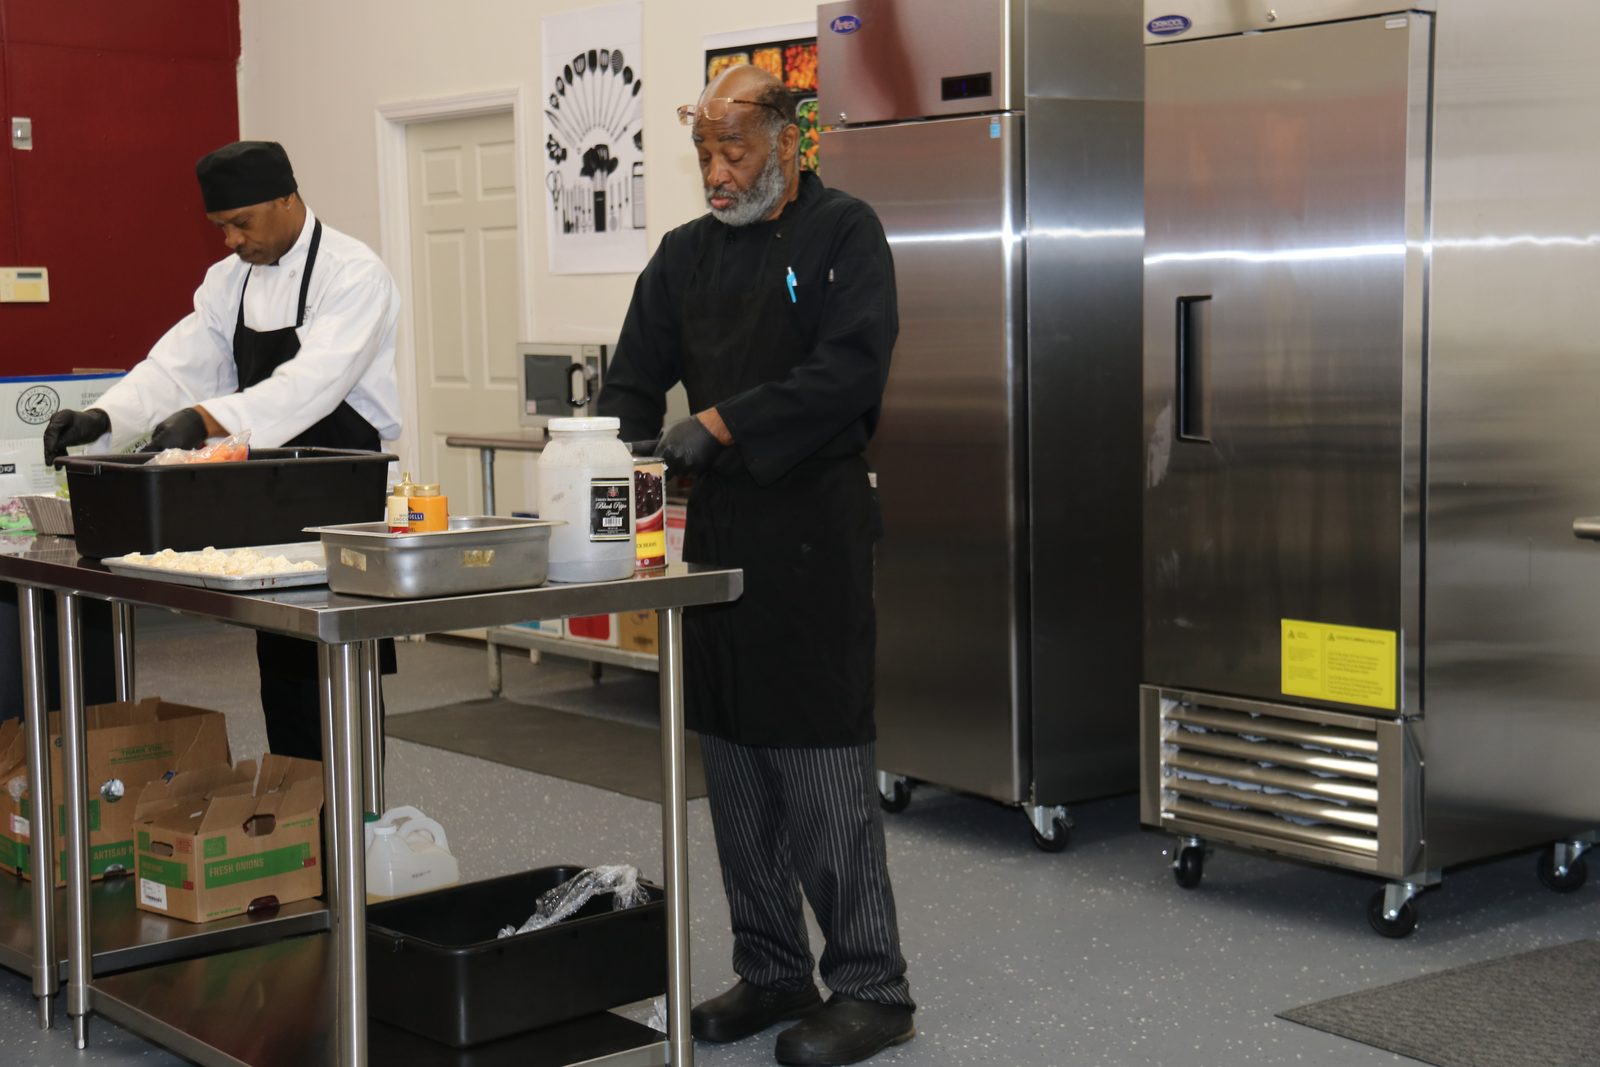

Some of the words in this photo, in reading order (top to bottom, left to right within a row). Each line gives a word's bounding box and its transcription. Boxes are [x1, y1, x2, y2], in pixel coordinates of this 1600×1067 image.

[94, 847, 127, 860] ARTISAN
[208, 863, 234, 878] FRESH
[235, 857, 265, 873] ONIONS
